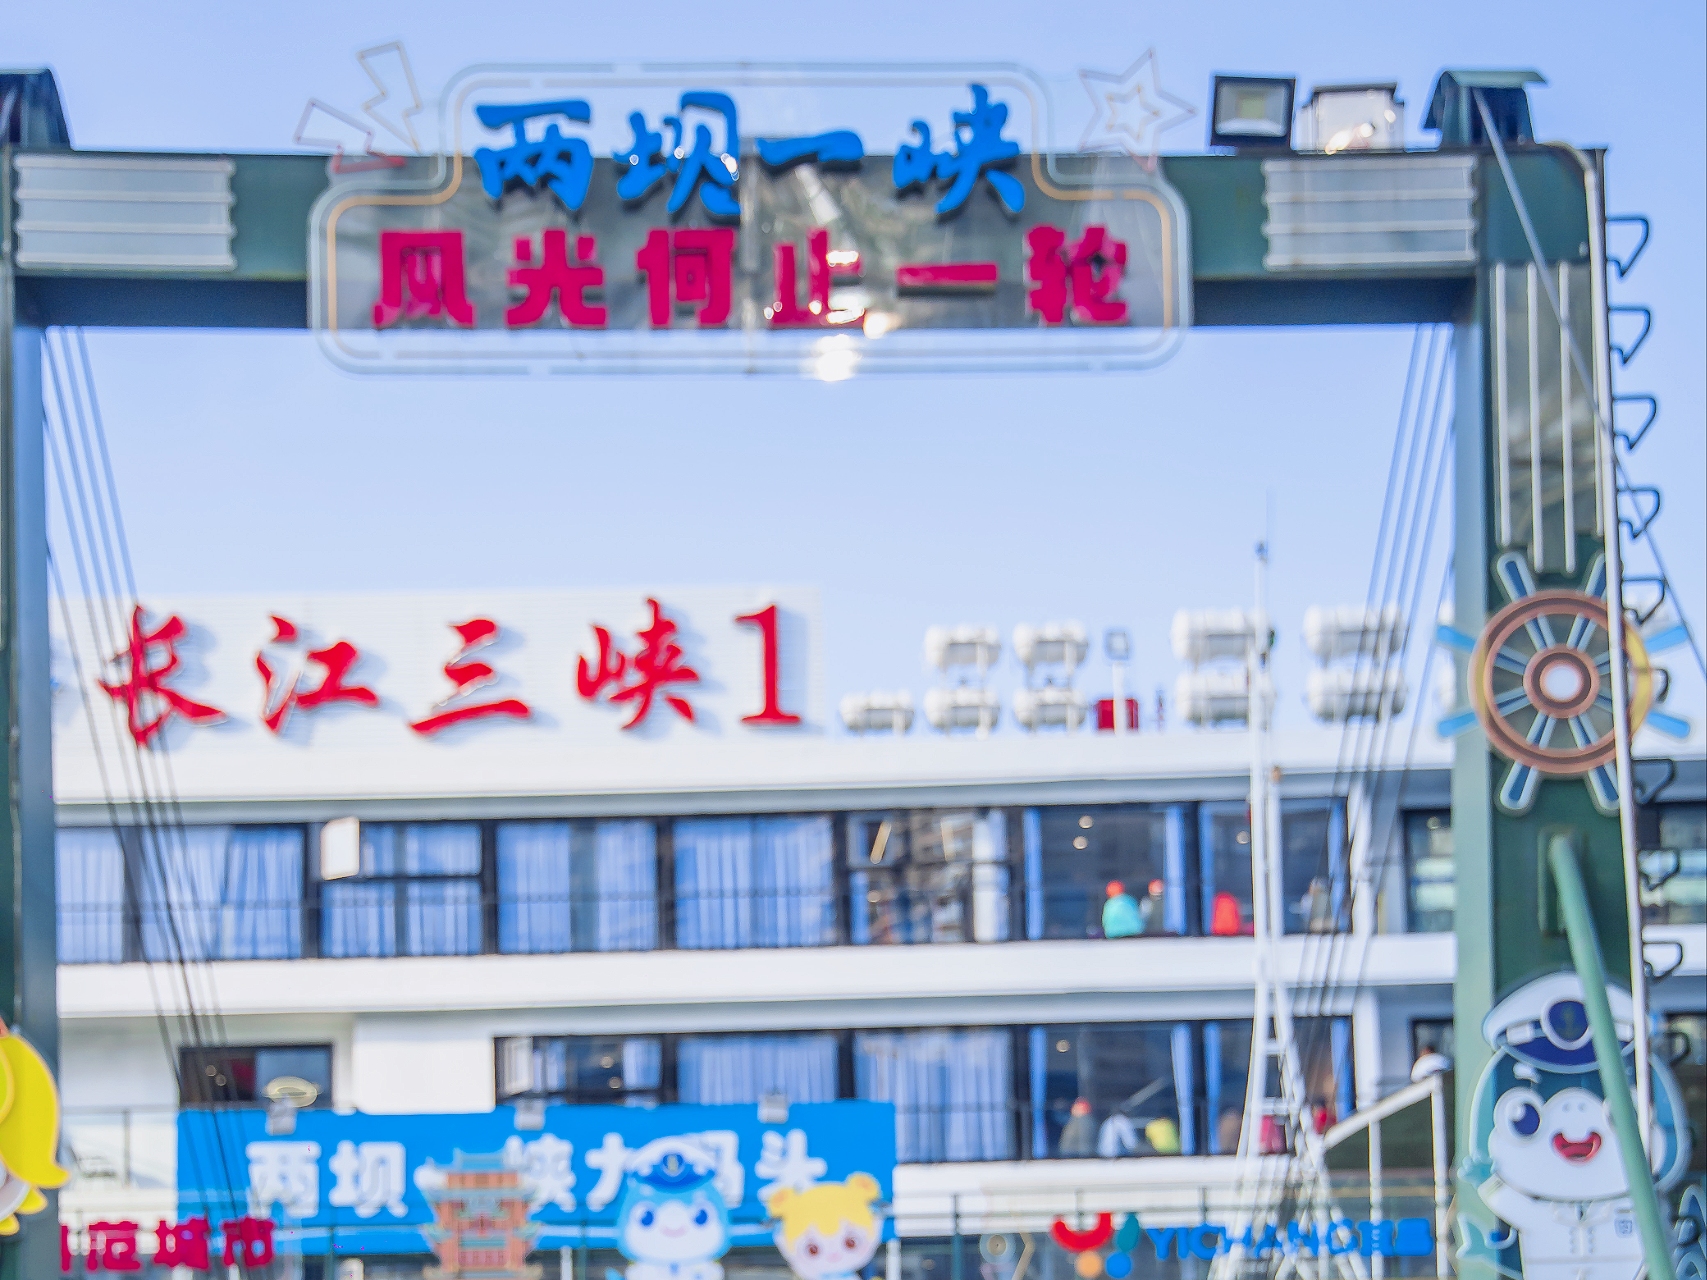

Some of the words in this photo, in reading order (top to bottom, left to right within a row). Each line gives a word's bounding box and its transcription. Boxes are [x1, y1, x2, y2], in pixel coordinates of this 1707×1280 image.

[474, 82, 1025, 214] 两坝一峡
[372, 225, 1130, 329] 风光何止一轮
[99, 597, 803, 749] 长江三峡1
